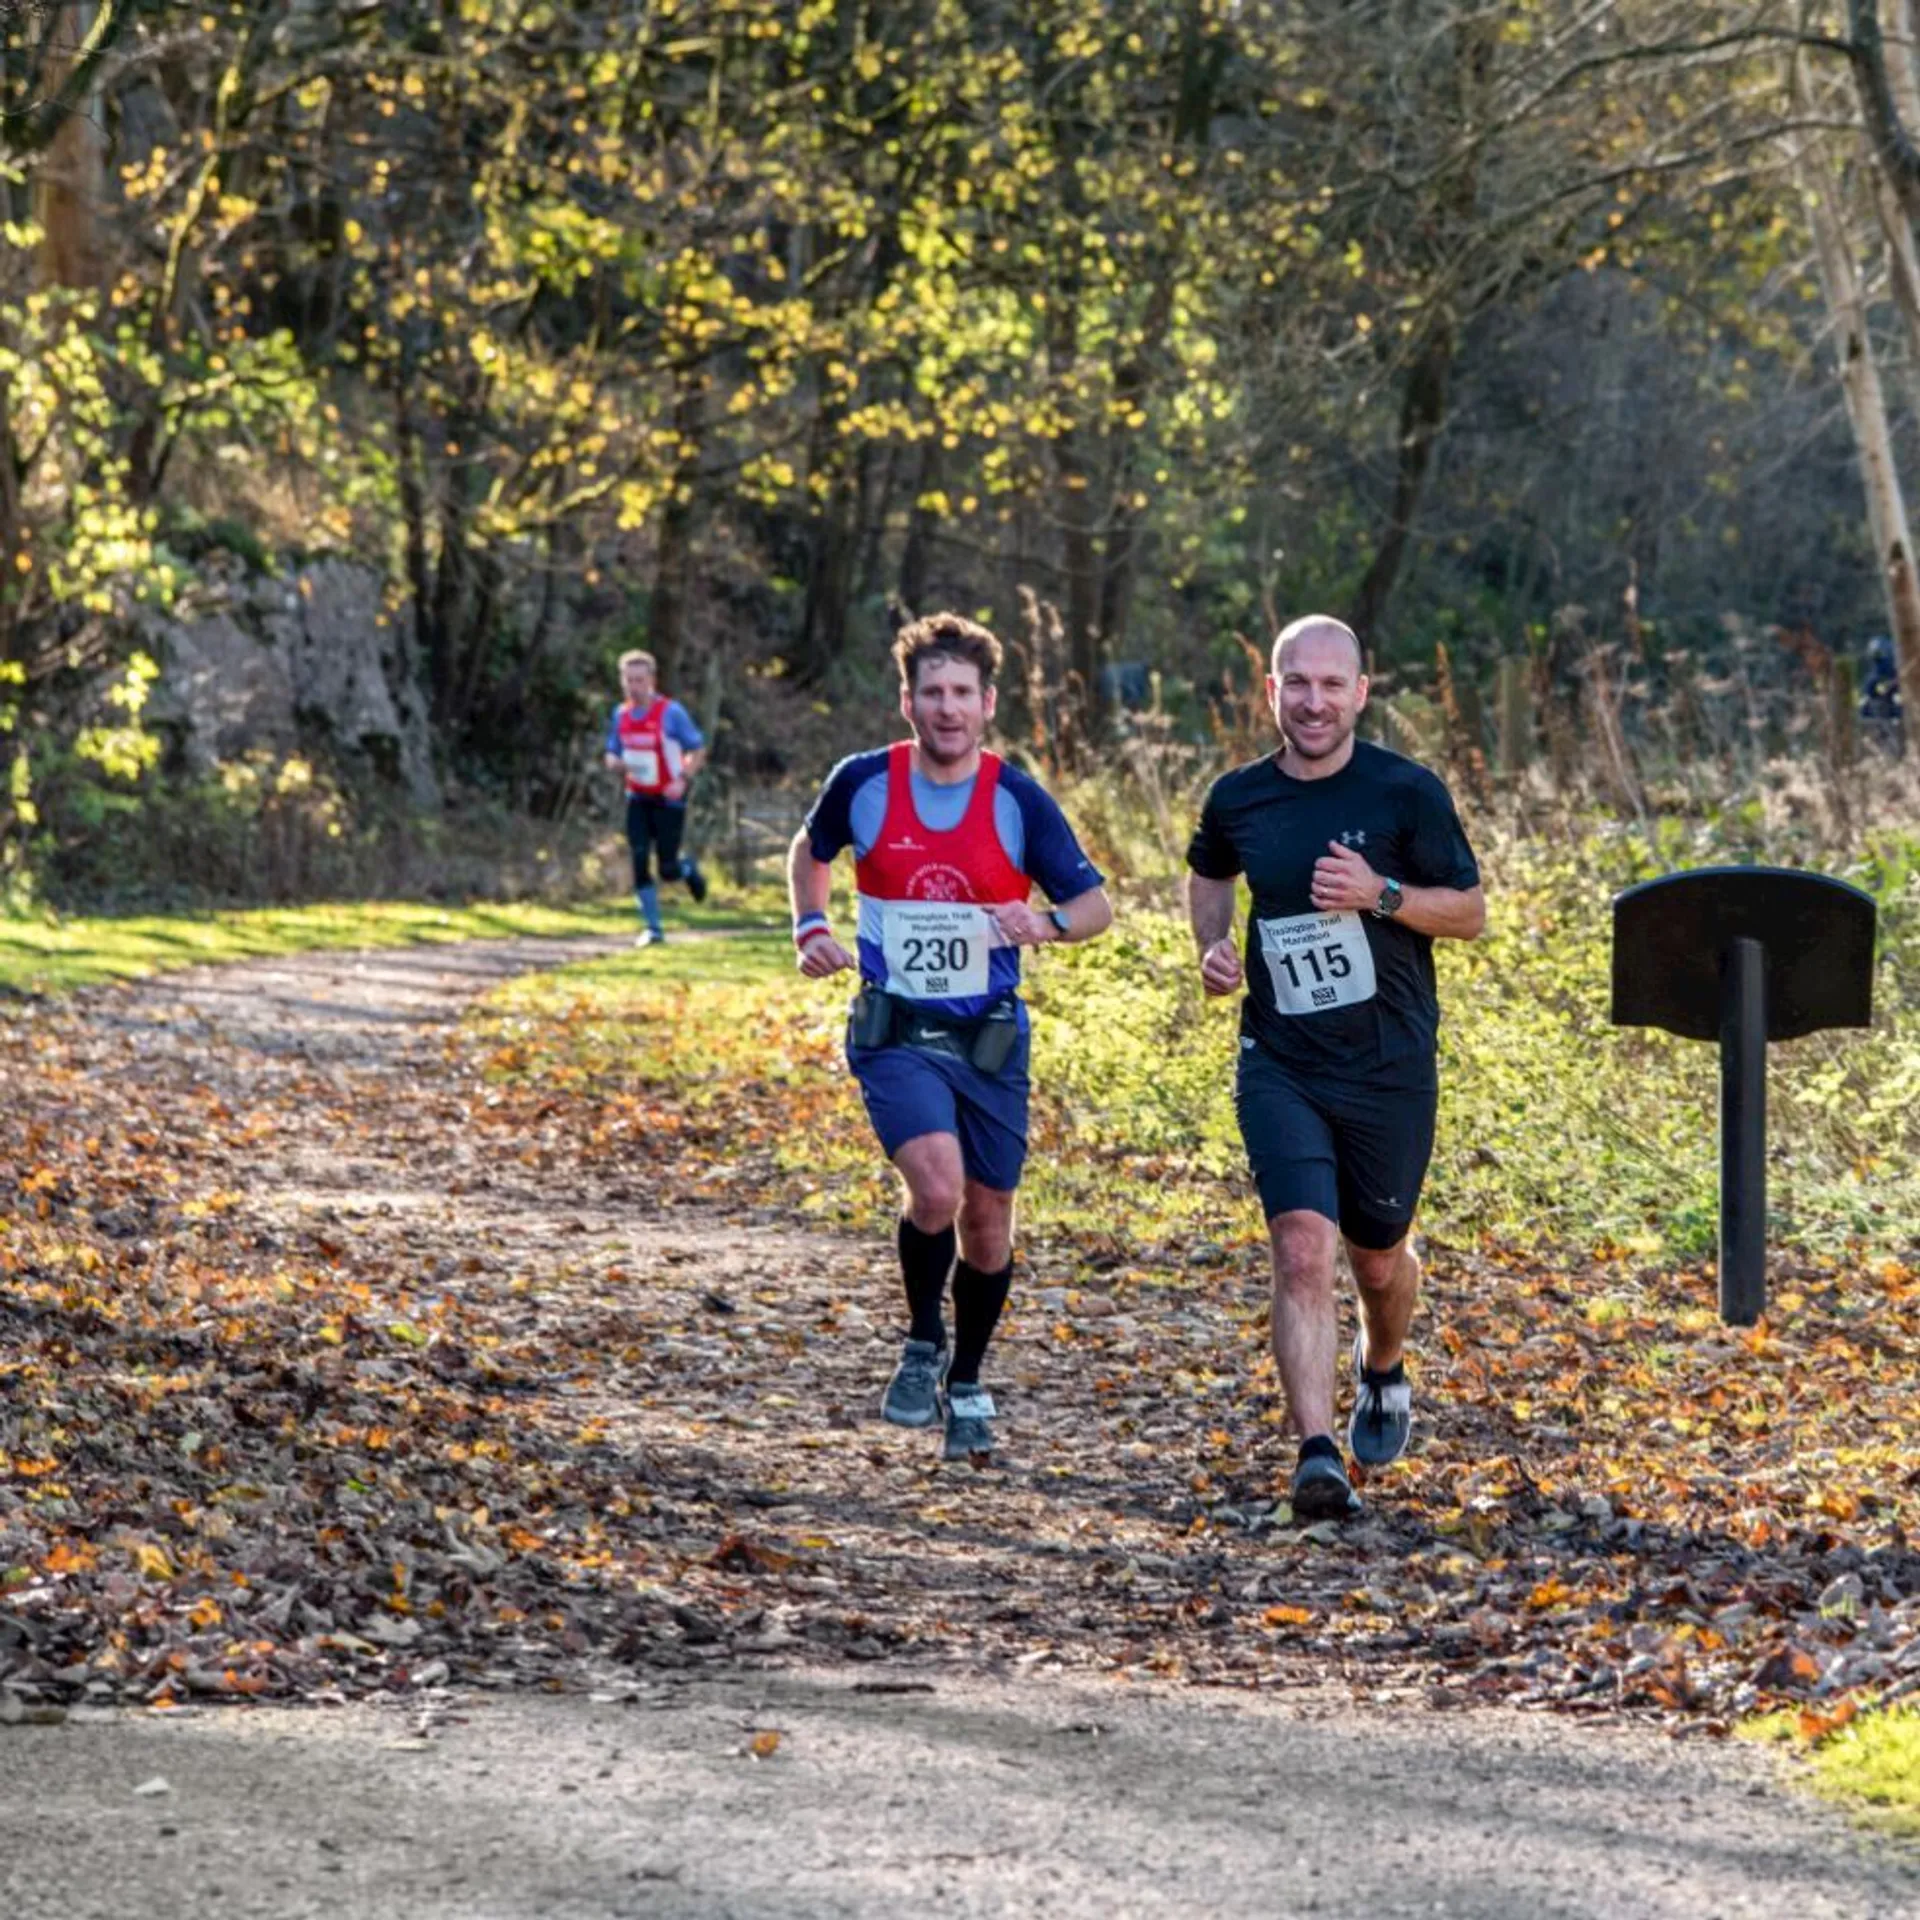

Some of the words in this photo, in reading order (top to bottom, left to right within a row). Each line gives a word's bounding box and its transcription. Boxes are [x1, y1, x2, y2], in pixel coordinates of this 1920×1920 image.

[952, 911, 972, 920] Trail
[1267, 922, 1317, 937] Tissington
[1319, 914, 1342, 928] Trail
[1282, 931, 1331, 946] Marathon
[903, 938, 969, 970] 230
[1280, 943, 1351, 987] 115
